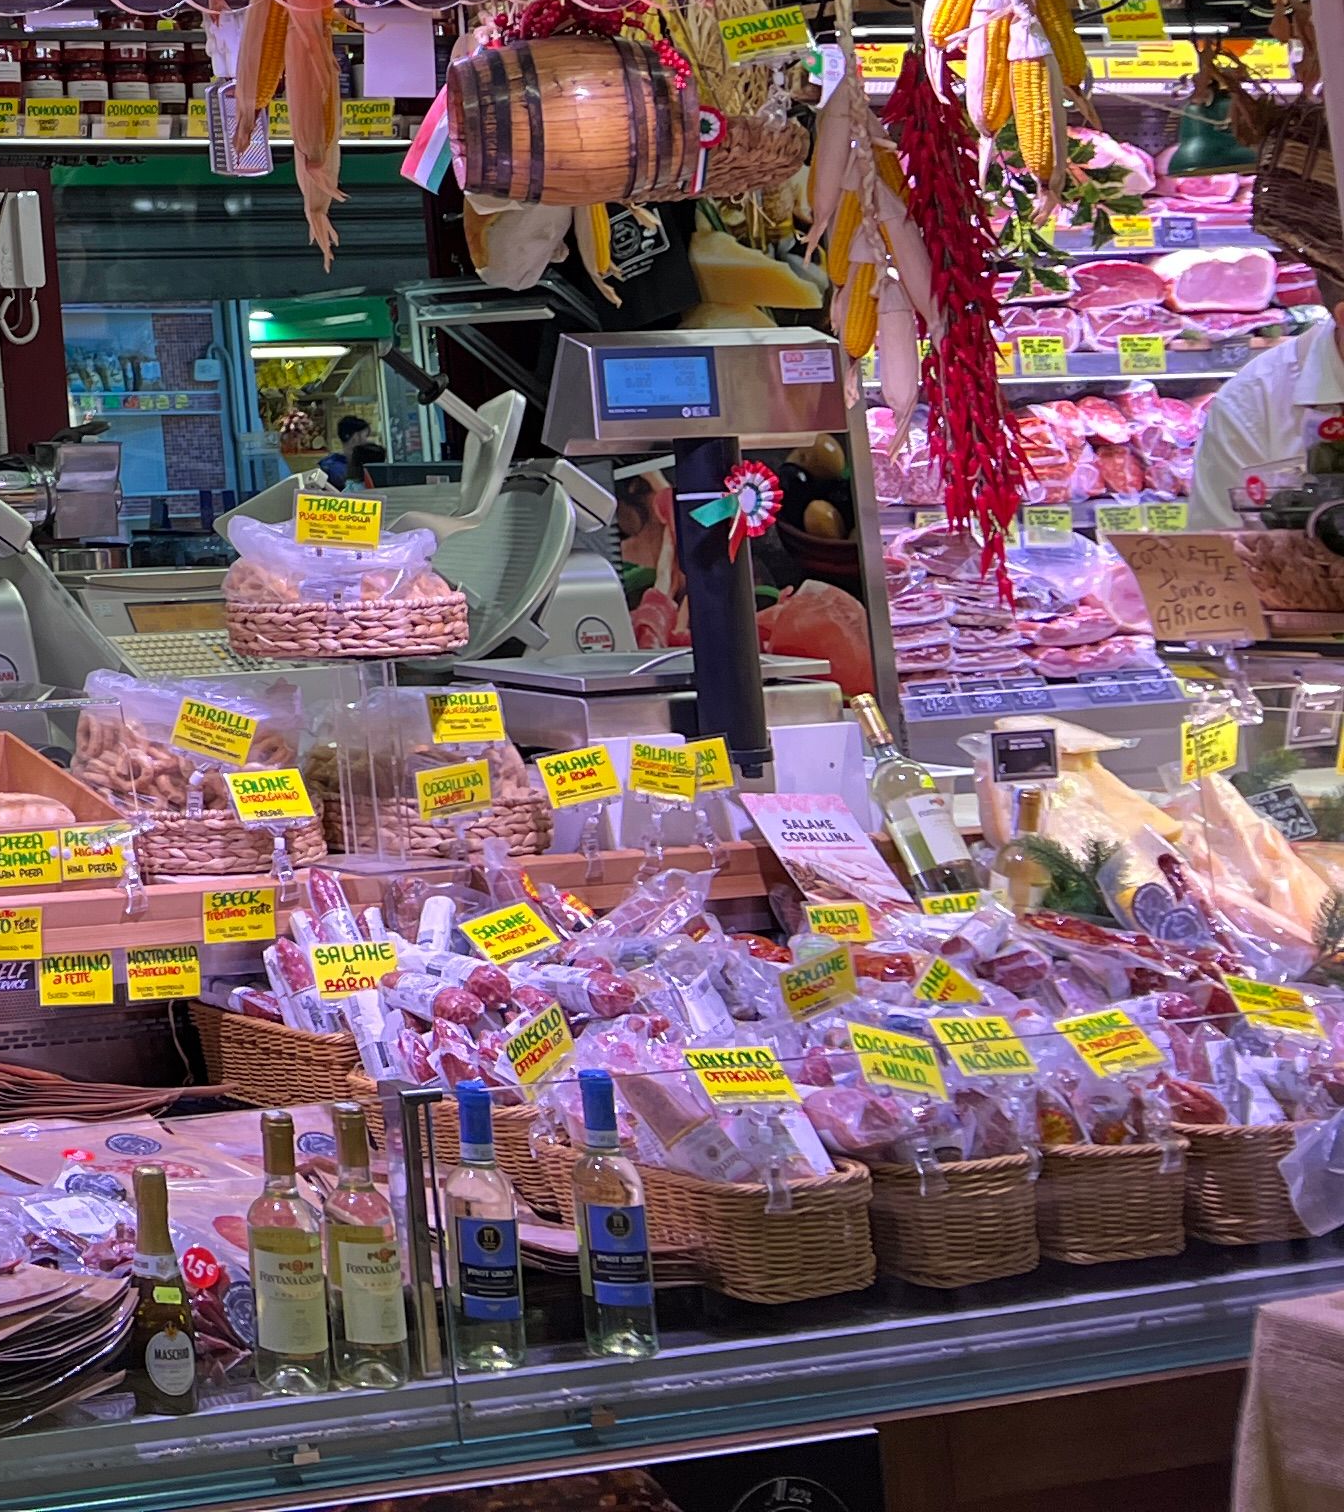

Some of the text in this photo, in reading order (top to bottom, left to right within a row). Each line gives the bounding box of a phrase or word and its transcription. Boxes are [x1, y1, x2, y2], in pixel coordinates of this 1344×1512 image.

[722, 9, 805, 42] GUANCIALE
[304, 497, 379, 516] TARALLI
[1156, 600, 1247, 630] ARICCIA
[430, 693, 489, 708] TARALLI
[186, 703, 250, 731] TARALLI
[544, 750, 606, 777] SALAME
[634, 744, 687, 765] SALAME
[233, 776, 290, 794] SALAME
[423, 773, 483, 796] CORALLINA
[782, 819, 836, 831] SALAME
[780, 830, 855, 844] CORALLINA
[211, 890, 260, 908] SPECK
[472, 911, 532, 940] SALAME
[42, 953, 111, 975] TACCHINO
[128, 945, 198, 965] MORTADELLA
[315, 942, 394, 966] SALAME
[342, 964, 360, 977] AL
[786, 954, 849, 985] SALAME
[324, 976, 378, 992] BAROL
[939, 1019, 1004, 1042] PALLE
[853, 1031, 935, 1067] COGLIONI
[959, 1049, 1031, 1070] NONNO
[685, 1049, 774, 1071] CIAUSCOLO
[154, 1347, 189, 1360] MASCHIO
